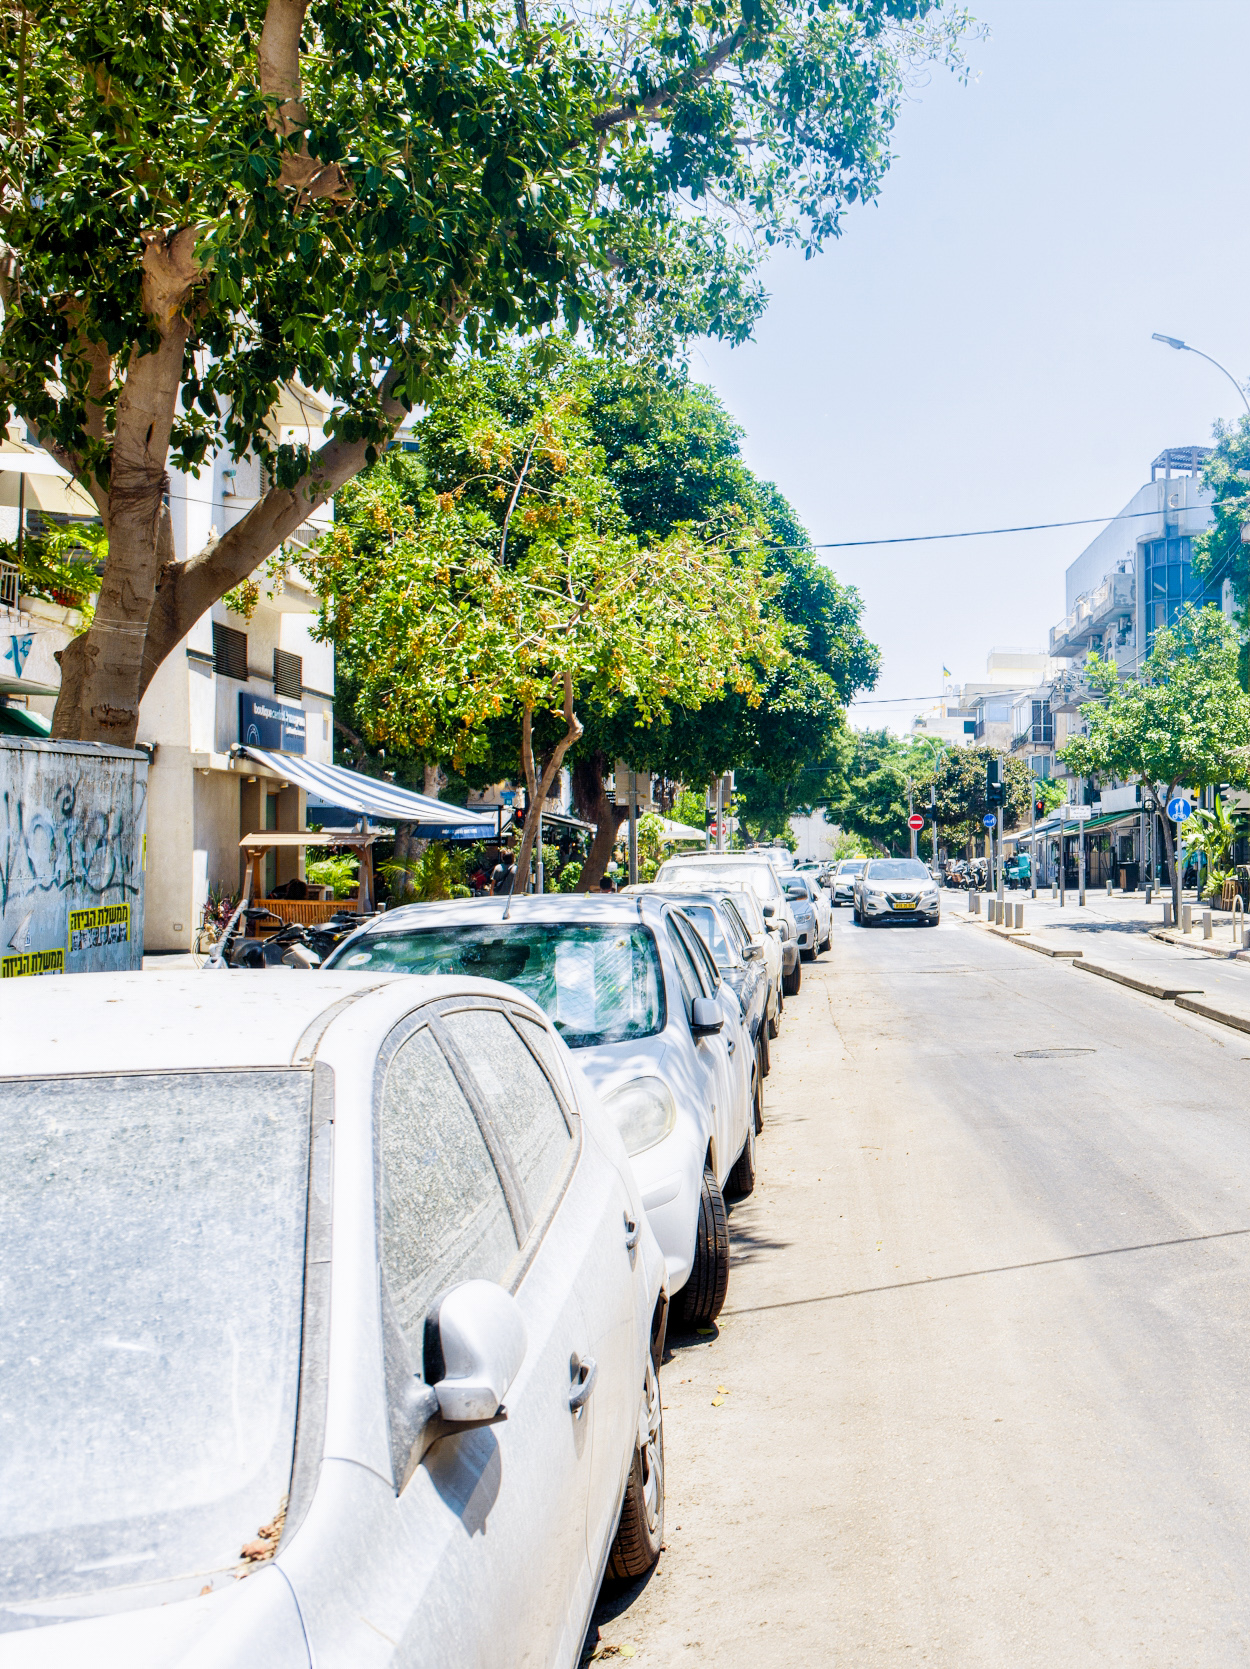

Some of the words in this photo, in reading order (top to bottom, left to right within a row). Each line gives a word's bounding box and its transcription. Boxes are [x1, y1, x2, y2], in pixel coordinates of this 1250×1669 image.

[70, 910, 96, 931] הביזה
[98, 905, 128, 925] ממשלת
[31, 950, 63, 973] ממשלת
